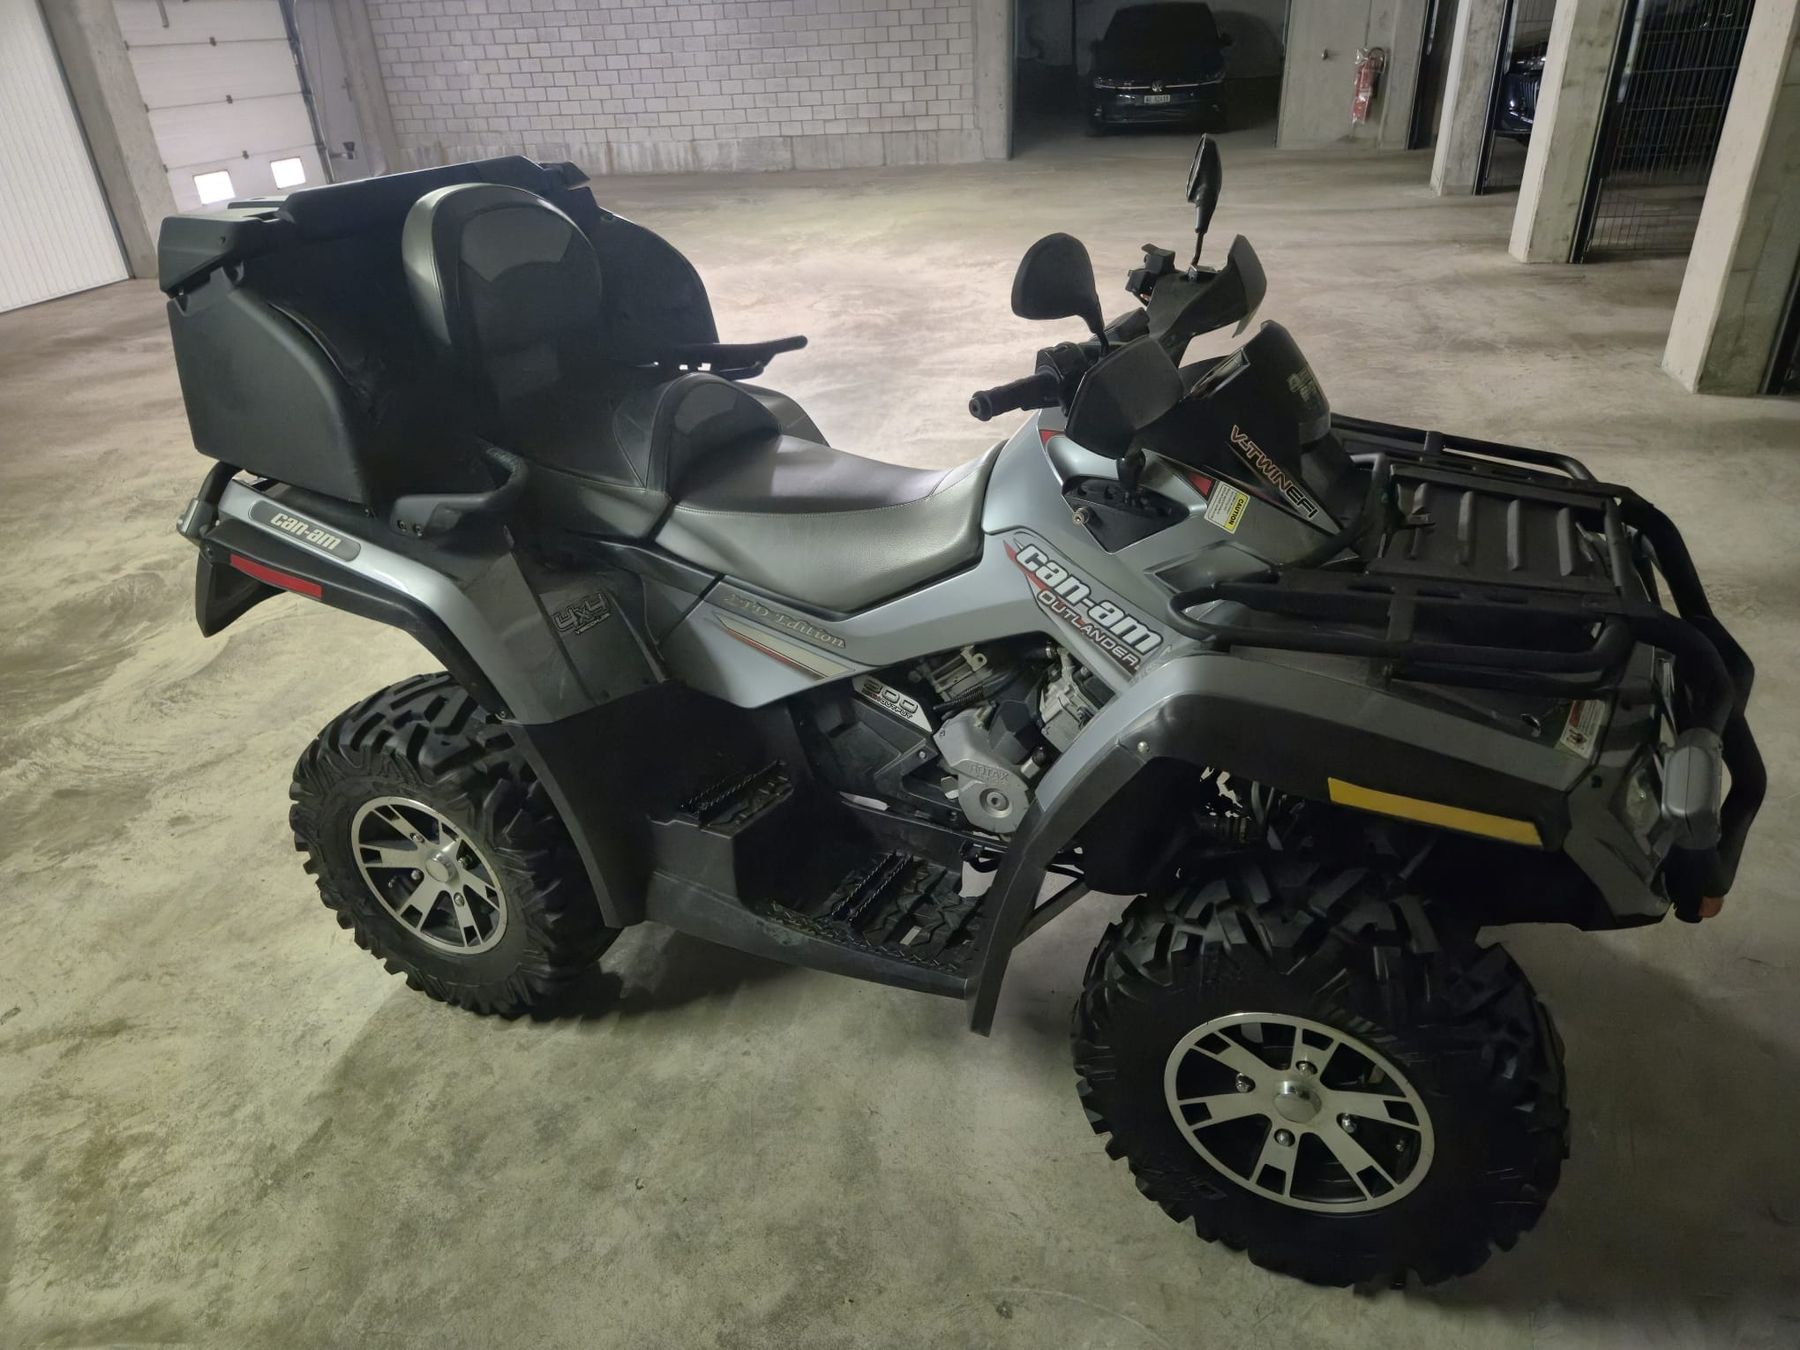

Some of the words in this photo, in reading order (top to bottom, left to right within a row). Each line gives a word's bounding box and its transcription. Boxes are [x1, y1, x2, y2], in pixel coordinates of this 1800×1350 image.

[1228, 498, 1245, 526] CAUTION
[270, 513, 341, 550] can-am
[1015, 544, 1164, 656] can-am
[775, 611, 846, 648] Edition
[1037, 589, 1139, 667] OUTLANDER
